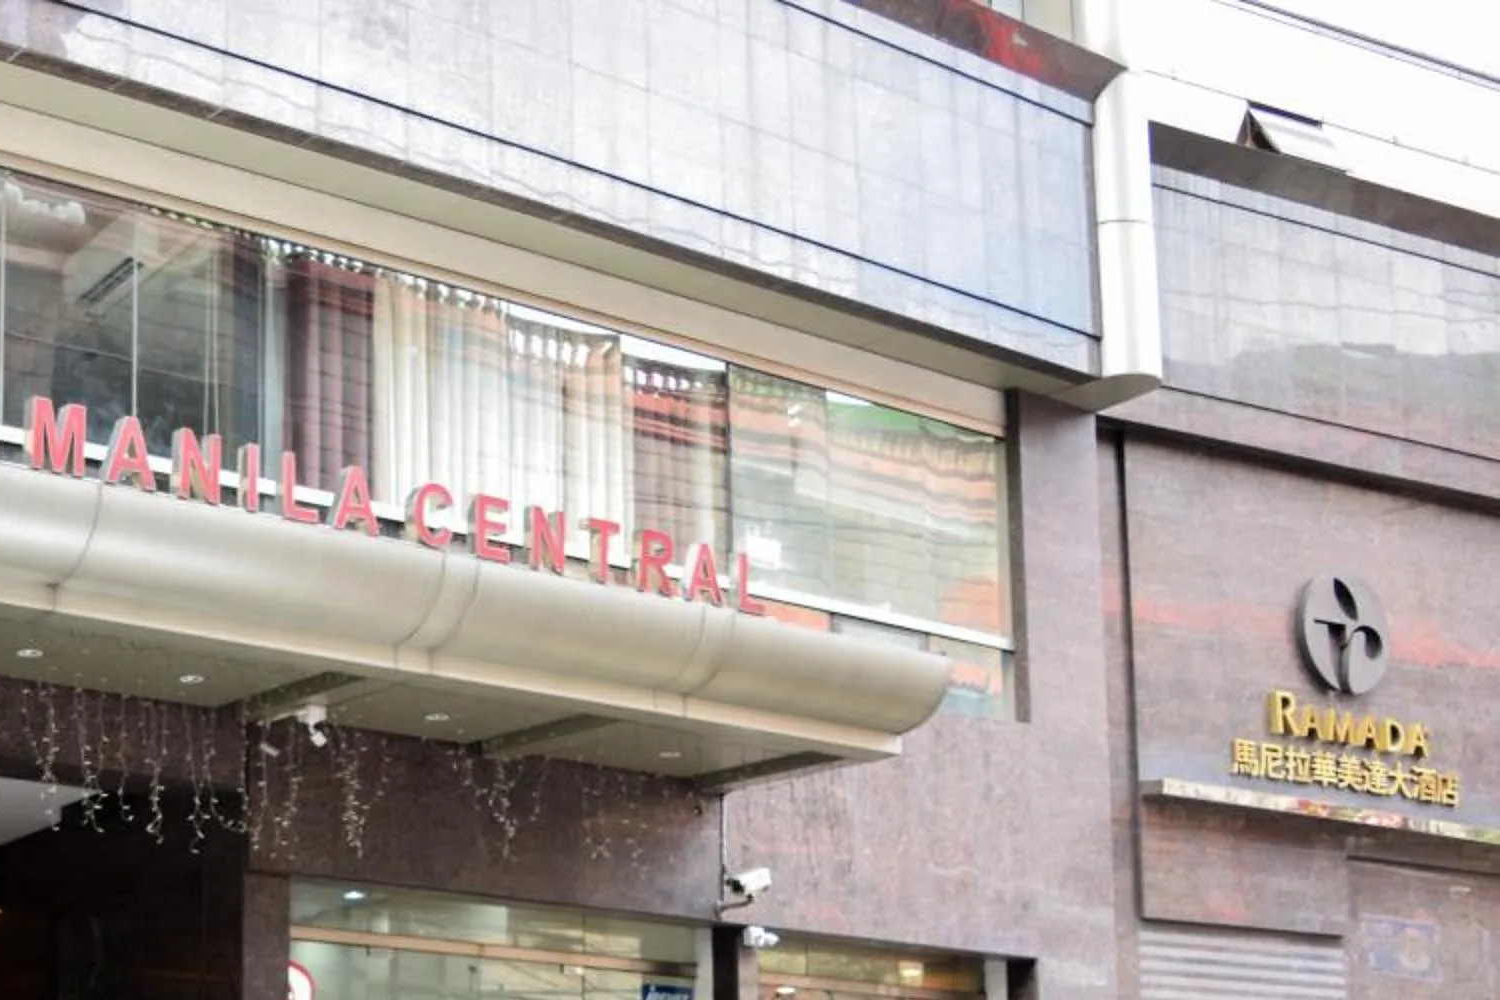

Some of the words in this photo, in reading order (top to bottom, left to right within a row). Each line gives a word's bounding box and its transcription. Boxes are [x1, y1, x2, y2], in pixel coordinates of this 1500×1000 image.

[29, 396, 380, 536] MANILA
[406, 482, 767, 616] CENTRAL
[1269, 689, 1431, 756] RAMADA
[1231, 738, 1462, 807] 馬尼拉華美達大酒店
